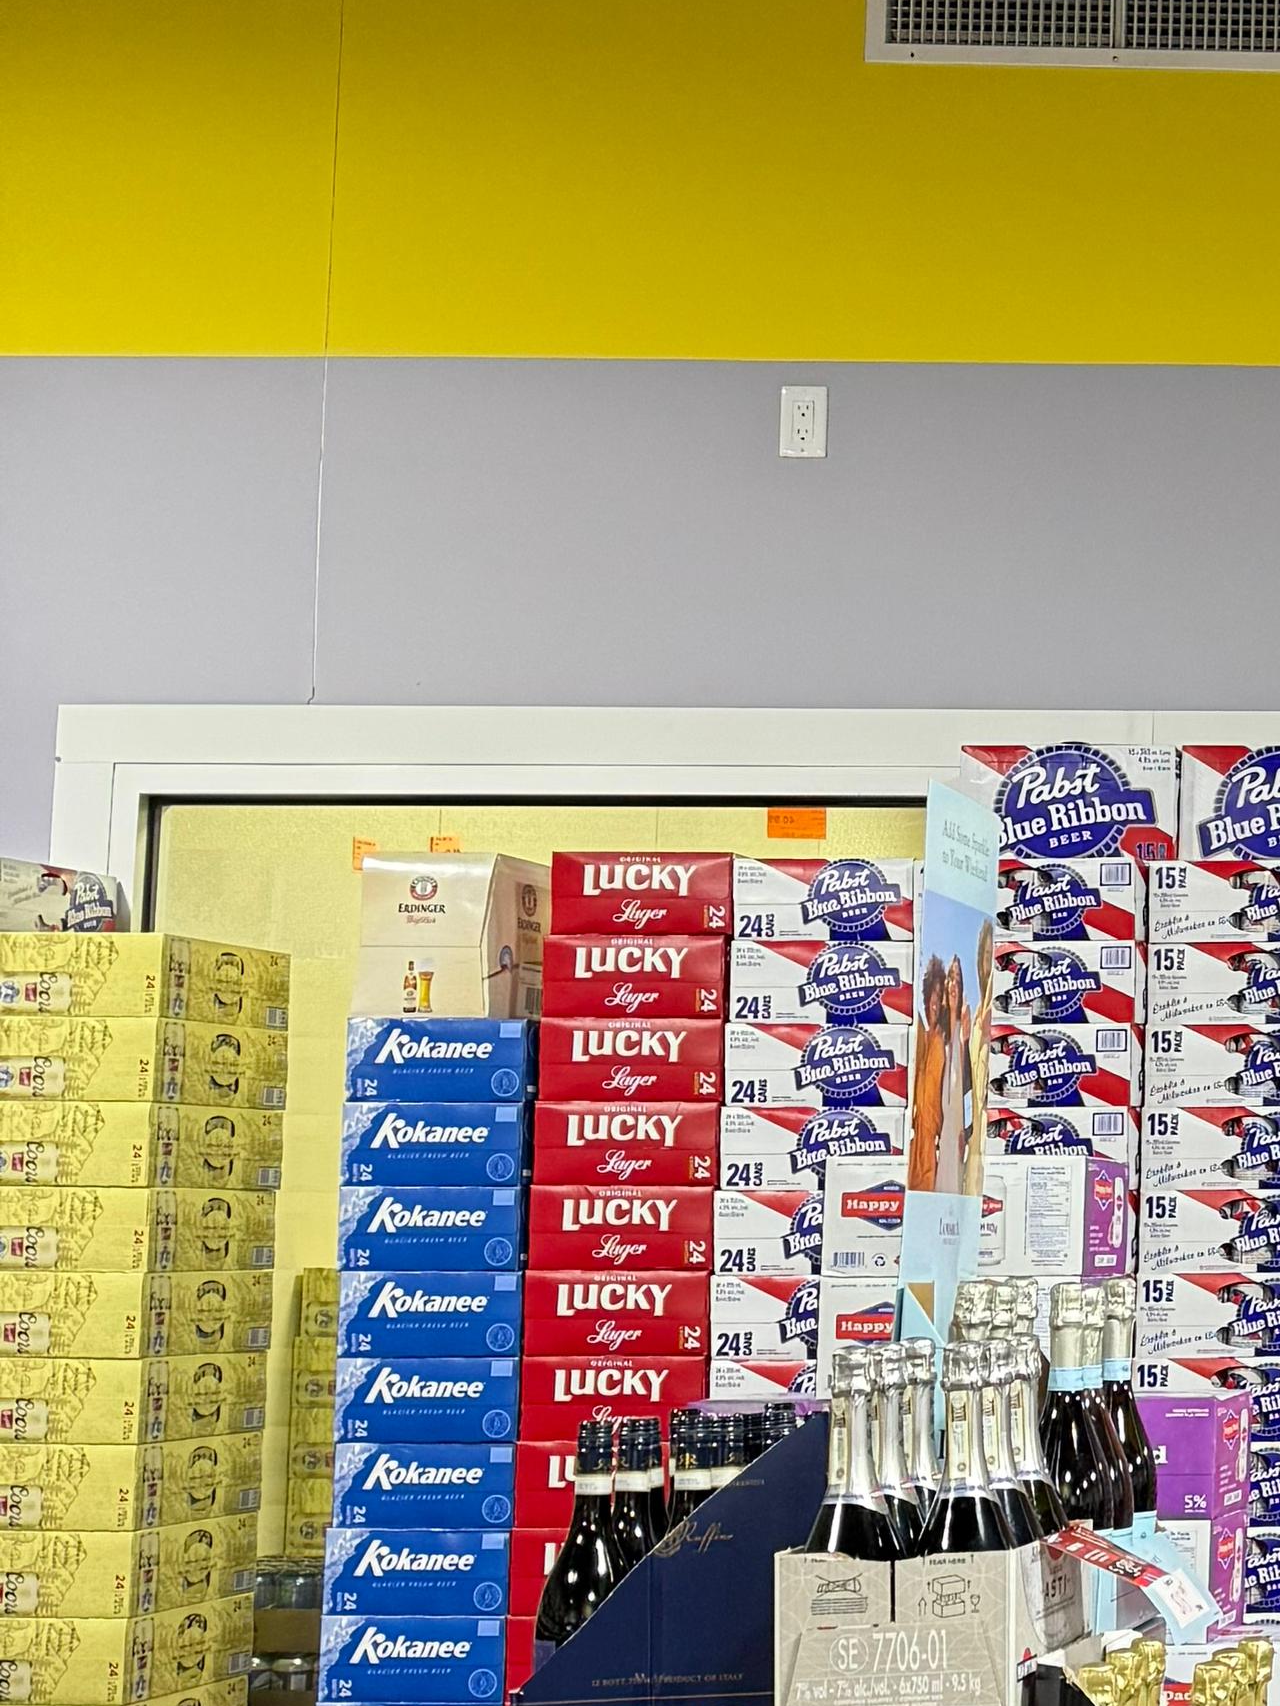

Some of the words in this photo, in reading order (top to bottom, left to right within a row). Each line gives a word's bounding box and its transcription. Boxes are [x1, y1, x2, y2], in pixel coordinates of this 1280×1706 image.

[1012, 763, 1102, 809] Pabst
[1050, 800, 1147, 832] Ribbon
[1049, 831, 1093, 849] BEER
[1207, 817, 1264, 847] Blue
[584, 863, 702, 896] LUCKY
[818, 868, 870, 894] Pabst
[1155, 866, 1176, 890] 15
[398, 903, 446, 916] ERDINGER
[613, 899, 667, 928] Lager
[709, 906, 725, 928] 24
[739, 915, 763, 937] 24
[818, 953, 869, 978] Pabst
[838, 973, 895, 991] Ribbon
[735, 996, 760, 1019] 24
[375, 1027, 495, 1064] Kokanee
[571, 1030, 686, 1063] LUCKY
[1151, 1030, 1172, 1054] 15
[603, 1066, 657, 1090] Lager
[370, 1113, 489, 1147] Kokanee
[561, 1198, 677, 1231] LUCKY
[846, 1199, 899, 1212] Happy
[592, 1234, 647, 1264] Lager
[362, 1453, 482, 1489] Kokanee
[838, 1638, 859, 1670] SE
[873, 1629, 948, 1672] 7706-01
